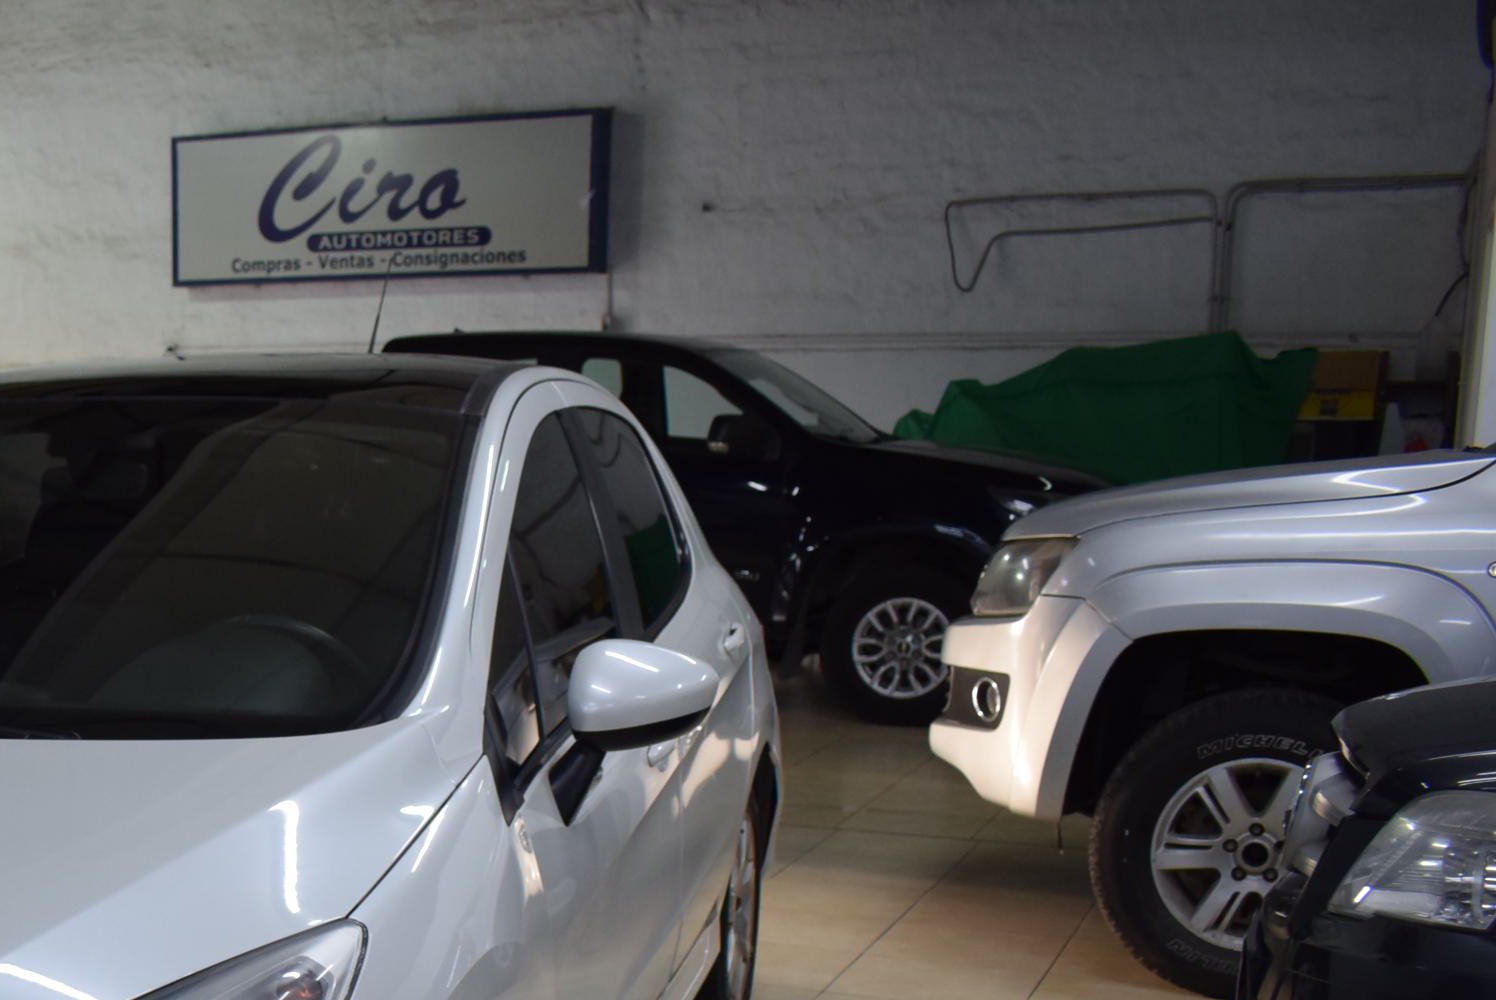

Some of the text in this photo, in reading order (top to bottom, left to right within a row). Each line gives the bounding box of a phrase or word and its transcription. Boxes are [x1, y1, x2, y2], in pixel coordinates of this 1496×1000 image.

[257, 134, 468, 243] Ciro
[318, 229, 480, 250] AUTOMOTORES
[231, 257, 301, 274] Compras
[318, 253, 375, 270] Ventas
[393, 248, 527, 271] Consignaciones
